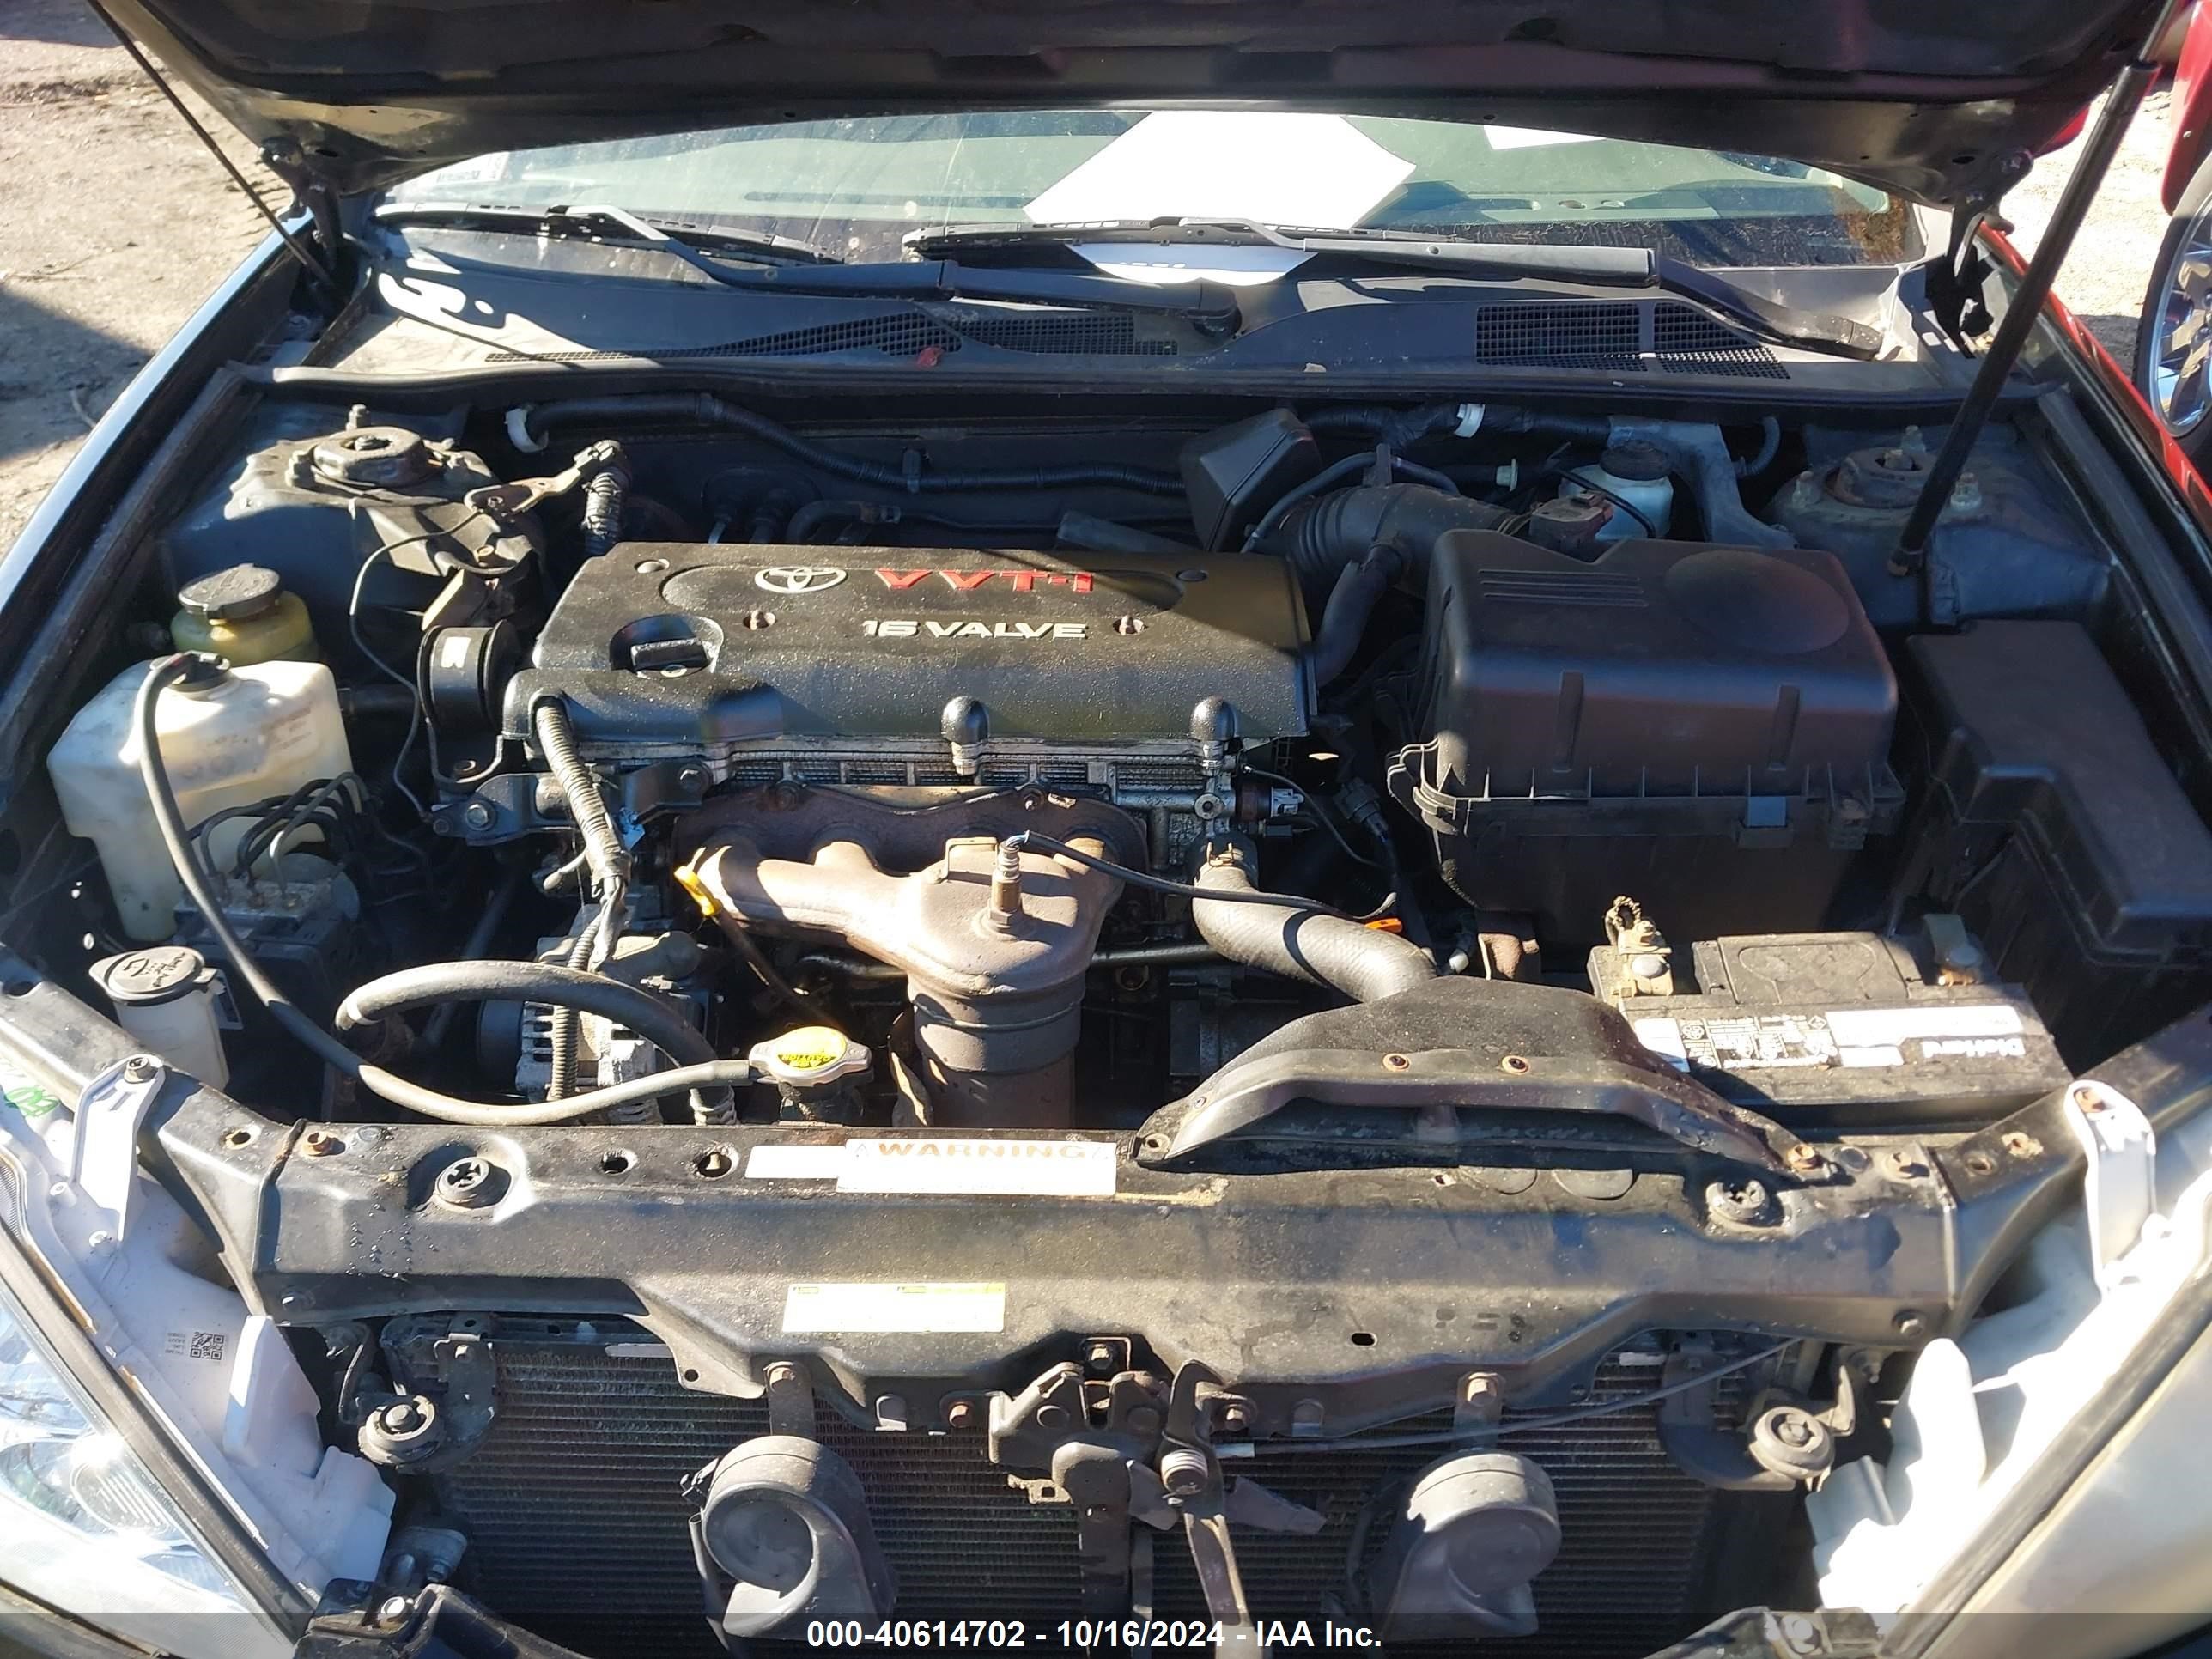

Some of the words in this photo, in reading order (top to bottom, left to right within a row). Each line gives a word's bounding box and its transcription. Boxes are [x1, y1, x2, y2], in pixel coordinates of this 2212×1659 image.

[861, 620, 918, 639] 16
[925, 622, 1089, 640] VALVE
[781, 1054, 832, 1062] CAUTION
[878, 1143, 1086, 1158] WARNING
